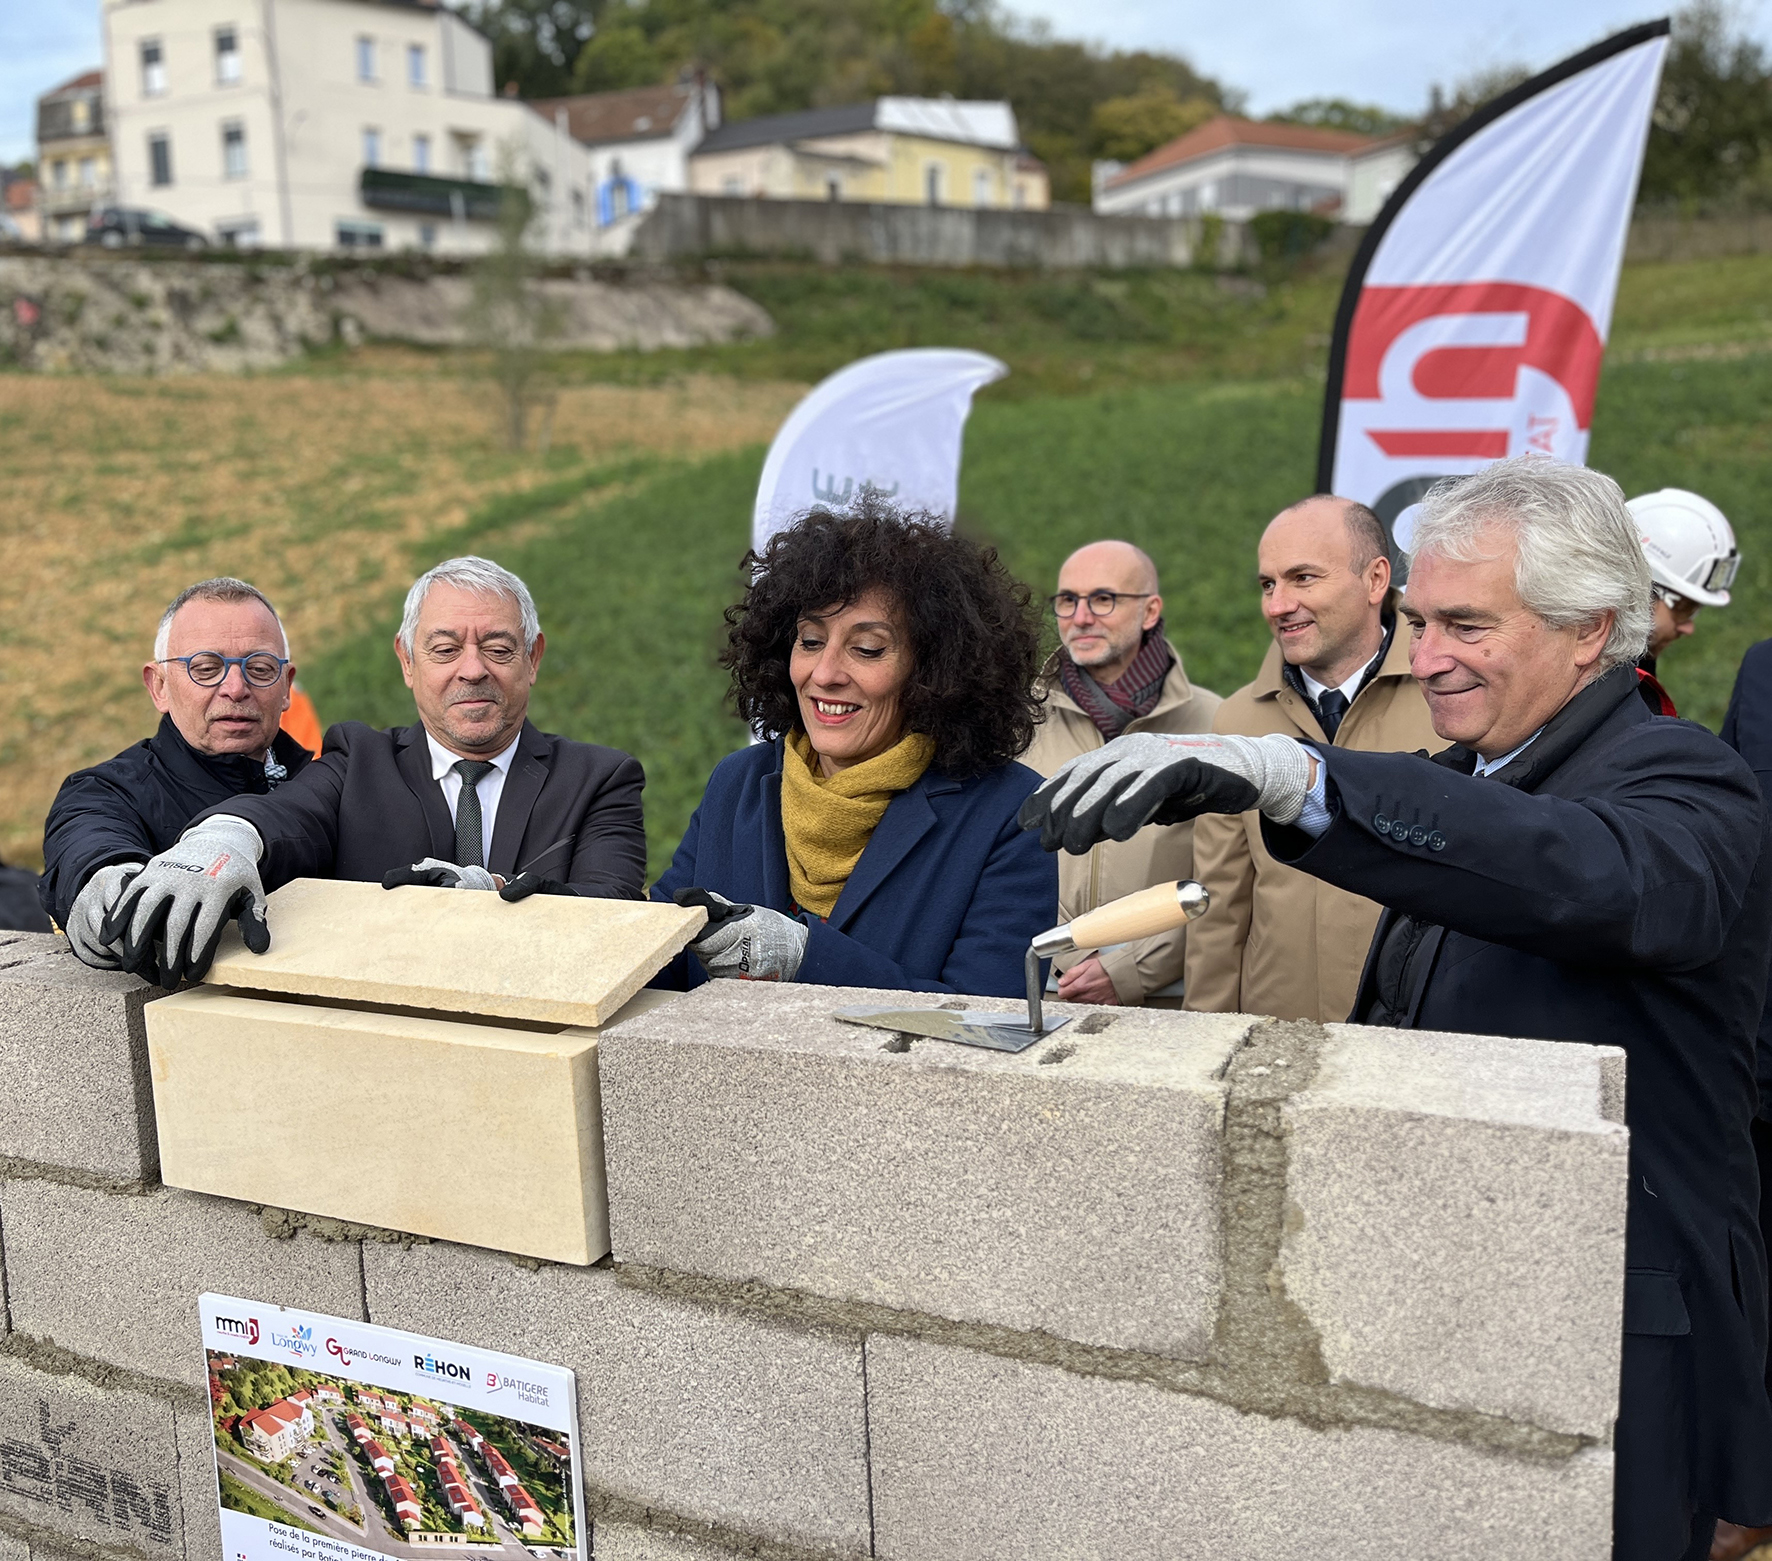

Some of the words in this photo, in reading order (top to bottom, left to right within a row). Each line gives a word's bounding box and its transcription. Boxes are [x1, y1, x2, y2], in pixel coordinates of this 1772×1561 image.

[271, 1332, 317, 1357] Longwy
[343, 1347, 367, 1359] GRAND
[414, 1353, 471, 1381] RÉHON
[503, 1377, 549, 1397] BATIGERE
[518, 1391, 550, 1407] Habitat
[268, 1523, 288, 1537] Pose
[289, 1528, 300, 1540] de
[301, 1531, 310, 1543] la
[312, 1536, 349, 1555] première
[269, 1539, 300, 1554] réalisés
[301, 1548, 316, 1559] par
